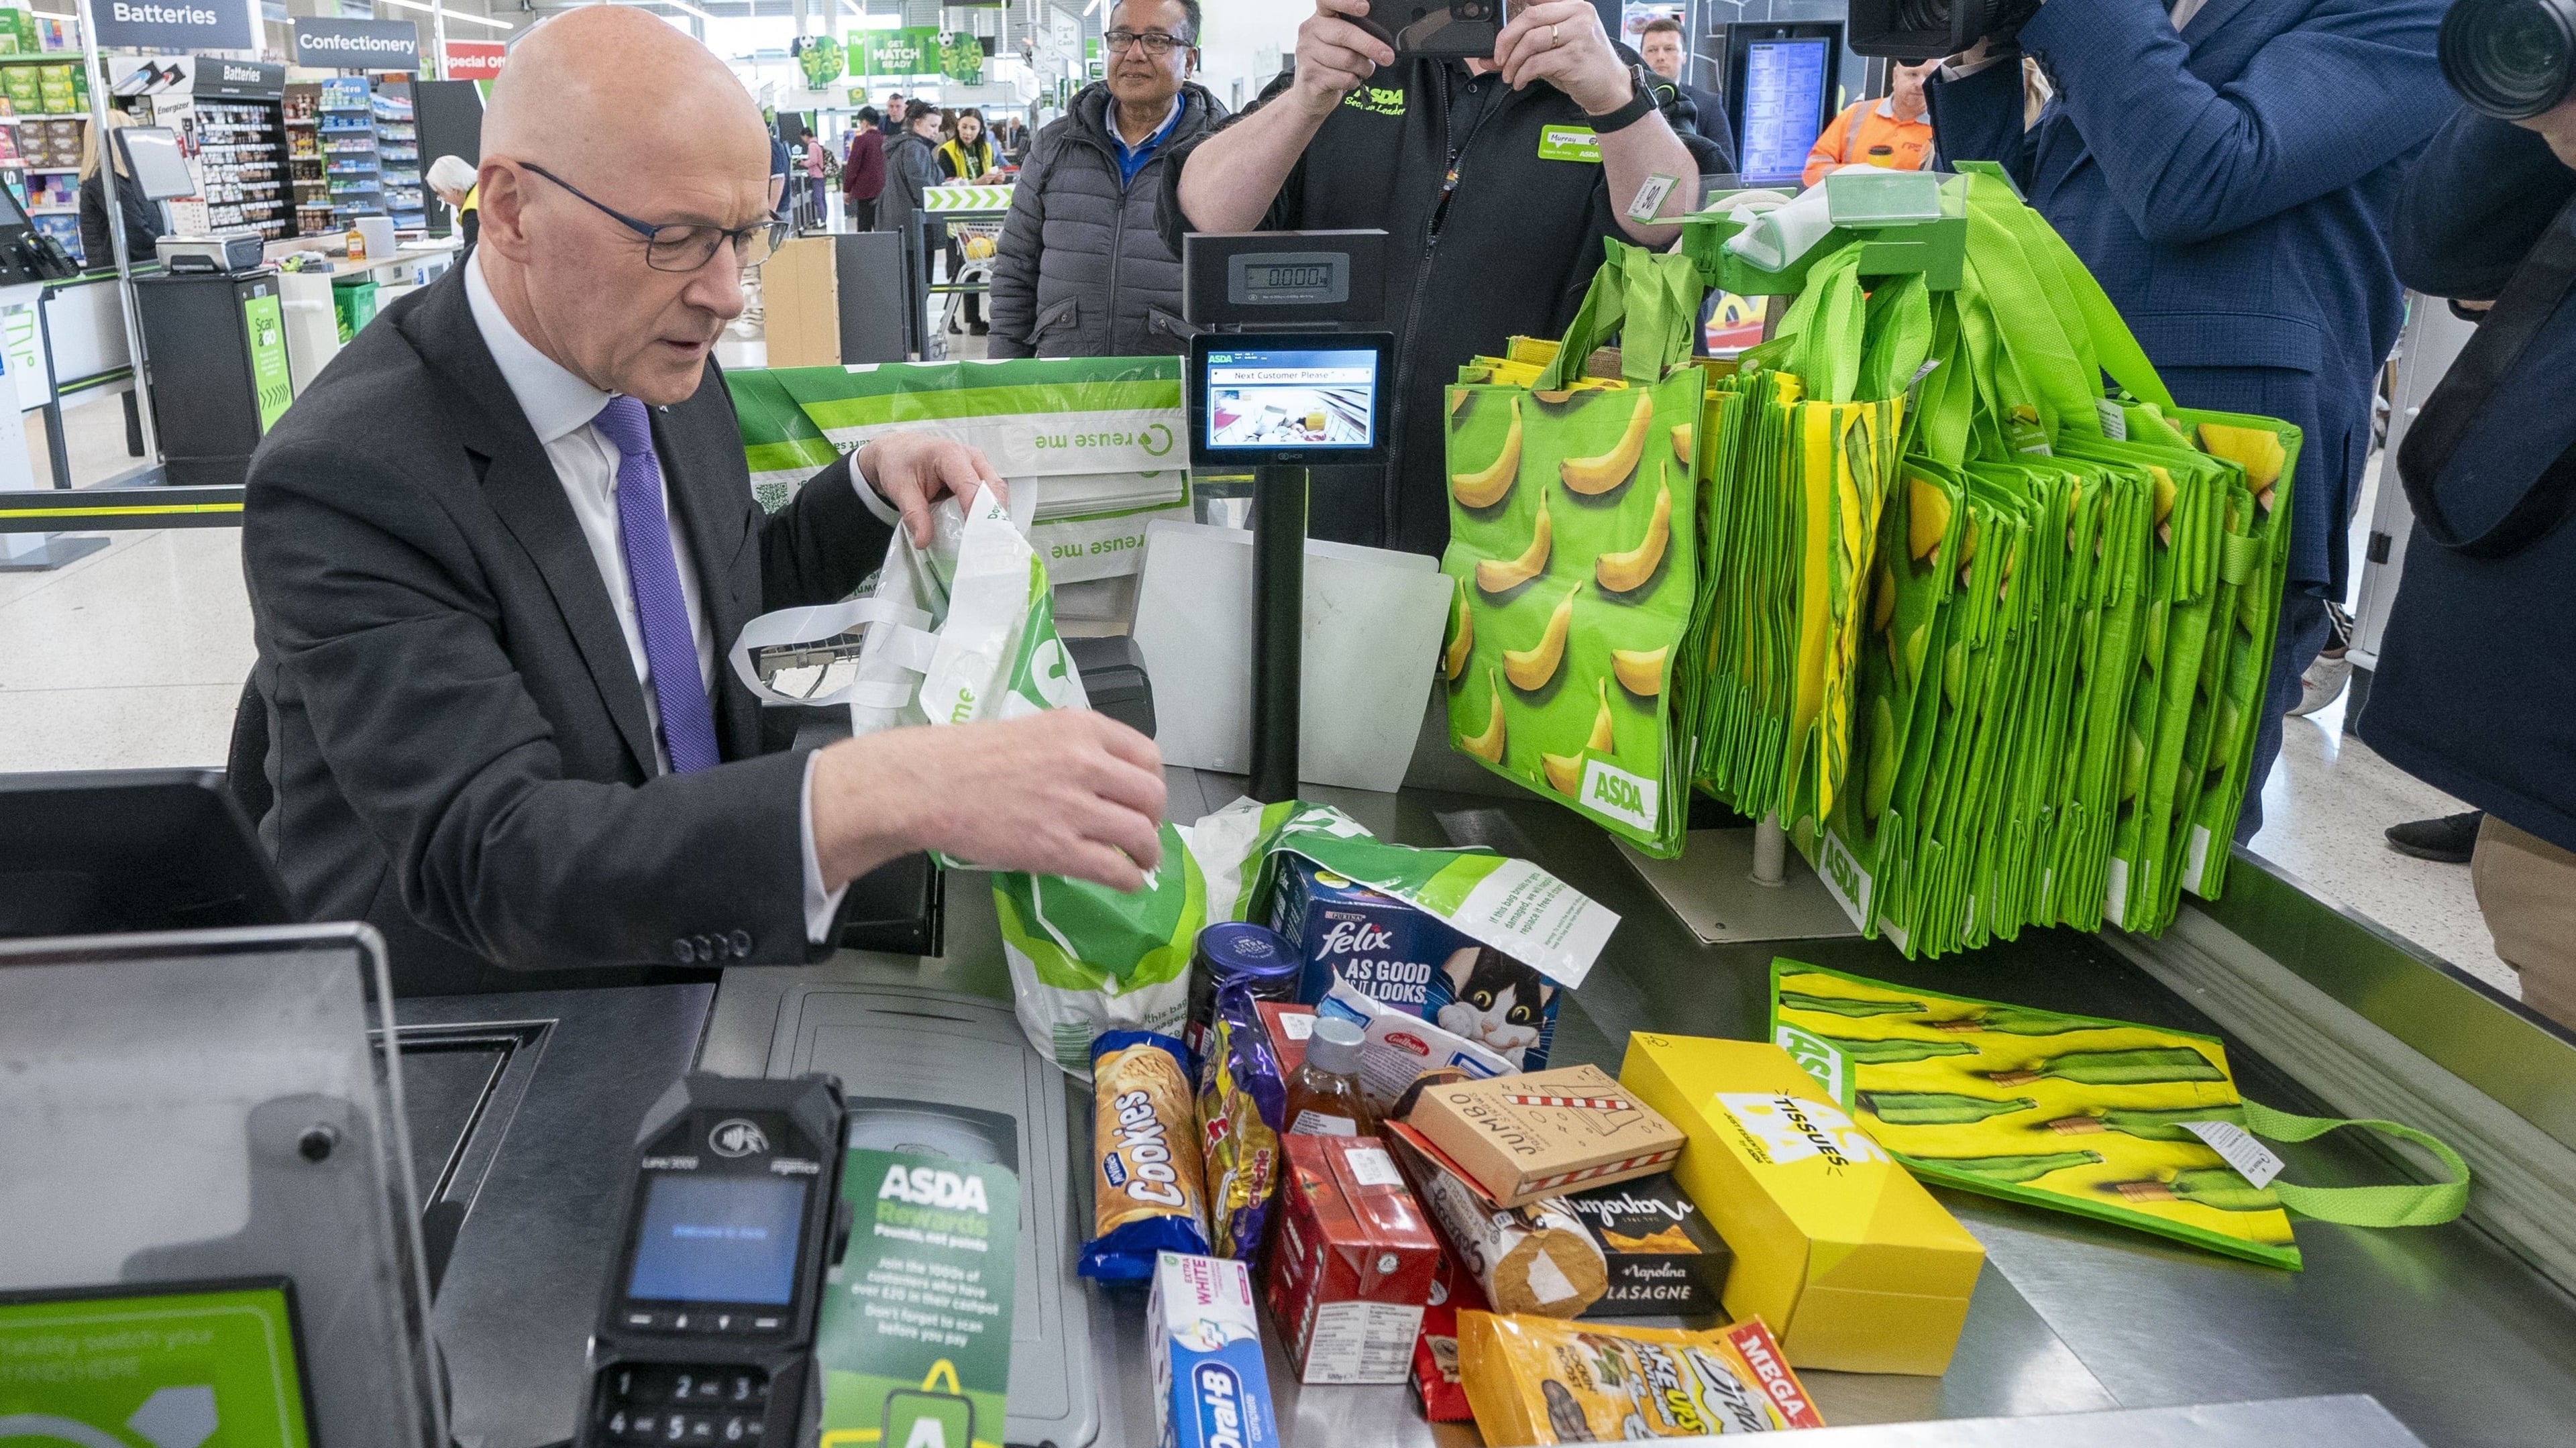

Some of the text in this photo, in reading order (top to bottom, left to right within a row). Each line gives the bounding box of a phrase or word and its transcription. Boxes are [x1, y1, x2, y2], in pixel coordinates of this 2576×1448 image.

[113, 2, 217, 25] Batteries
[300, 34, 416, 54] Confectionery
[873, 49, 920, 60] MATCH
[888, 40, 904, 48] GET
[223, 65, 260, 82] Batteries
[881, 60, 912, 68] READY
[157, 101, 189, 115] Energizer
[1376, 105, 1405, 115] Leader
[1551, 134, 1576, 144] Murray
[1269, 269, 1320, 286] 0.000
[256, 318, 274, 332] Scan
[1208, 355, 1233, 364] ASDA
[1234, 371, 1329, 380] Next Customer Please
[1035, 433, 1133, 449] reuse me
[1051, 535, 1144, 559] reuse me
[1594, 771, 1646, 818] ASDA
[1824, 841, 1863, 904] ASDA
[1493, 906, 1508, 918] this
[1501, 893, 1517, 907] bag
[1505, 901, 1533, 930] damaged,
[1527, 893, 1537, 901] we
[1519, 911, 1541, 935] replace
[1538, 896, 1552, 909] free
[1334, 913, 1362, 922] PURINA
[1315, 922, 1393, 961] felix
[1345, 958, 1431, 984] AS GOOD
[1358, 980, 1369, 995] IT
[1371, 982, 1426, 1003] LOOKS
[1147, 1011, 1167, 1023] this
[1390, 1035, 1426, 1054] Galbani
[1450, 1094, 1536, 1155] JUMBO
[1774, 1097, 1849, 1167] TISSUES
[1114, 1090, 1185, 1207] Cookies
[877, 1164, 989, 1214] ASDA
[876, 1199, 988, 1237] Rewards
[1574, 1192, 1695, 1228] Napolin
[874, 1223, 988, 1252] Pounds, not points
[879, 1257, 904, 1270] Join
[906, 1260, 926, 1274] the
[1182, 1258, 1193, 1284] EXTRA
[1622, 1263, 1686, 1285] Napolina
[1193, 1259, 1212, 1306] WHITE
[1607, 1286, 1692, 1300] LASAGNE
[941, 1315, 954, 1328] to
[620, 1372, 631, 1394] 1
[676, 1375, 692, 1398] 2
[735, 1377, 750, 1400] 3
[1741, 1335, 1807, 1416] MEGA
[610, 1411, 627, 1434] 4
[668, 1415, 684, 1439] 5
[726, 1416, 743, 1441] 6
